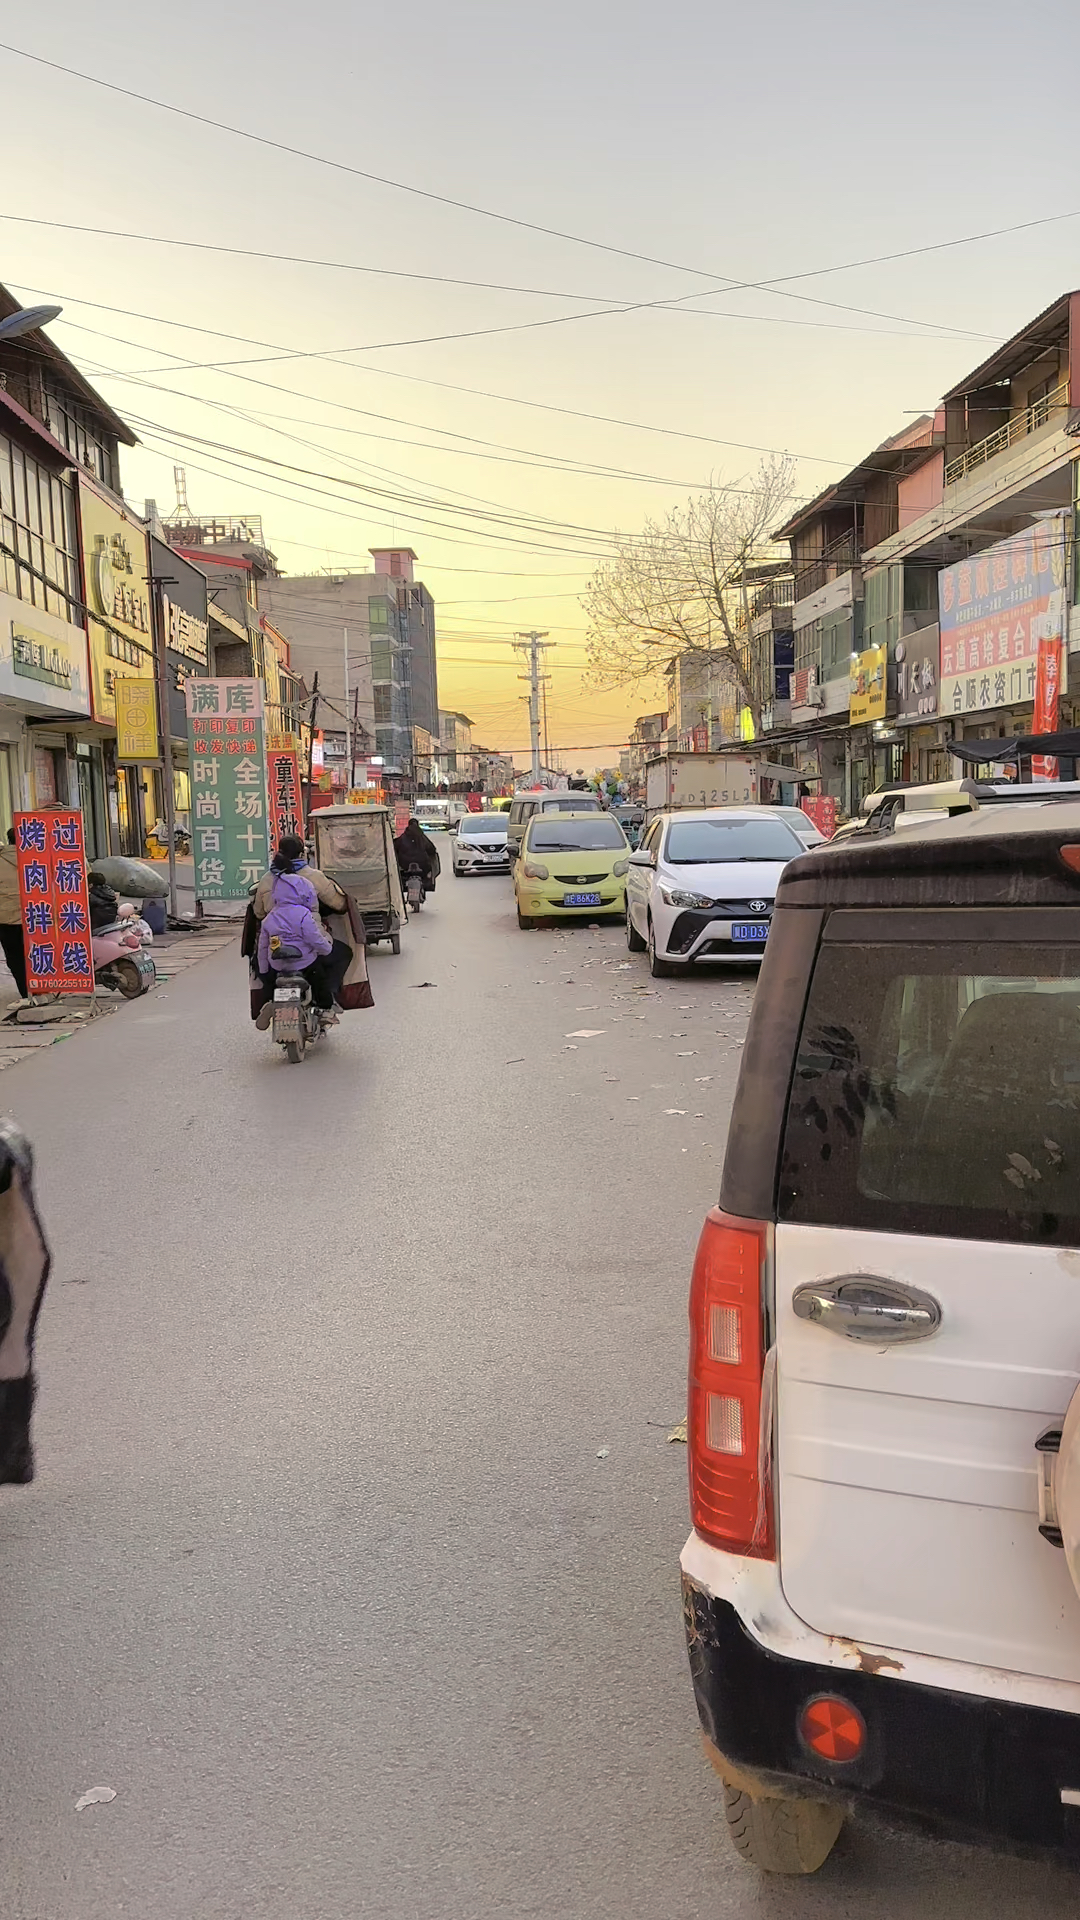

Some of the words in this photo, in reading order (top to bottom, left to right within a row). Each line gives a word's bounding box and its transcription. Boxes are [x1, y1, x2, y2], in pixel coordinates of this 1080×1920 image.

[191, 683, 255, 714] 满库
[193, 718, 256, 735] 打印复印
[194, 738, 257, 755] 收发快递
[193, 757, 226, 887] 时尚百货
[233, 757, 266, 886] 全场十元
[19, 817, 57, 976] 烤肉拌饭
[52, 817, 91, 976] 过桥米线
[39, 978, 92, 989] 17602255137
